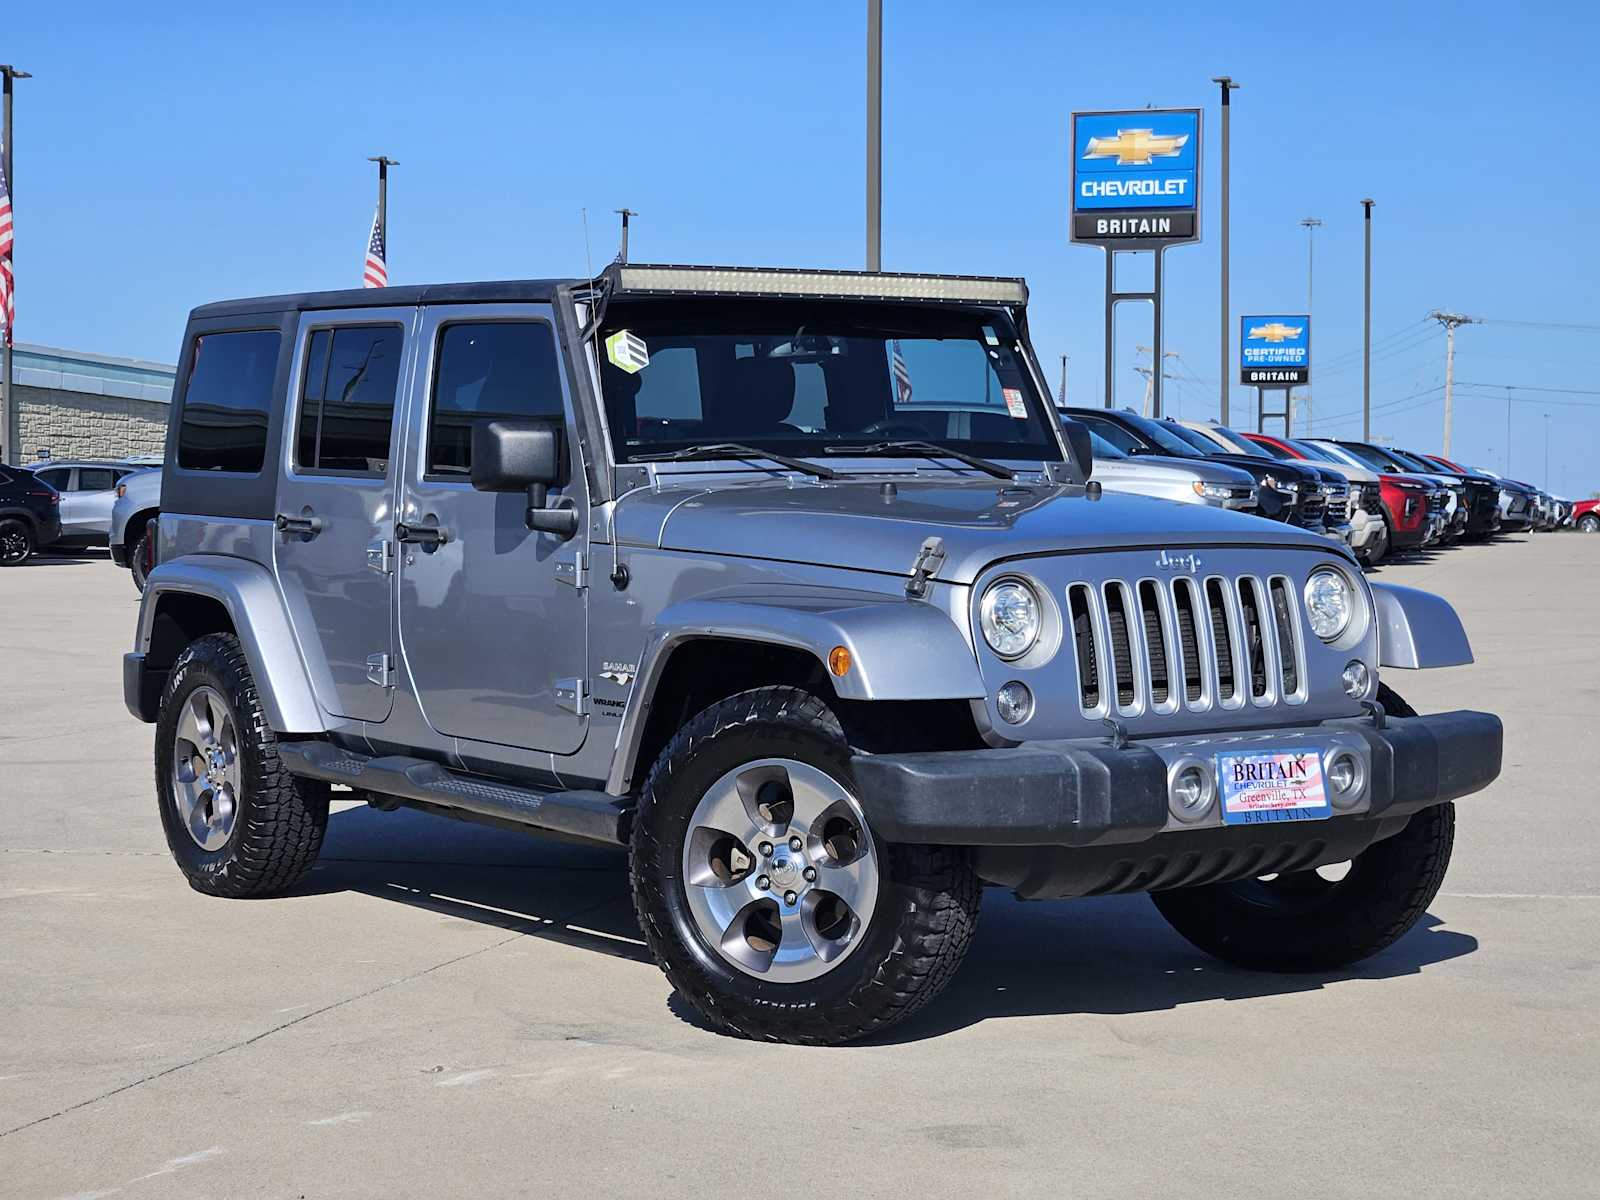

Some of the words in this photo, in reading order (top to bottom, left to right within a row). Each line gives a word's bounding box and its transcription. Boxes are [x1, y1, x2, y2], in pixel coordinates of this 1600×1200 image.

[1081, 179, 1188, 197] CHEVROLET
[1097, 218, 1171, 234] BRITAIN
[1244, 348, 1306, 356] CERTIFIED
[1250, 371, 1299, 381] BRITAIN
[1155, 549, 1202, 573] Jeep
[1233, 760, 1307, 782] BRITAIN
[1234, 780, 1288, 790] CHEVROLET
[1292, 788, 1307, 799] TX
[1243, 807, 1312, 822] BRITAIN
